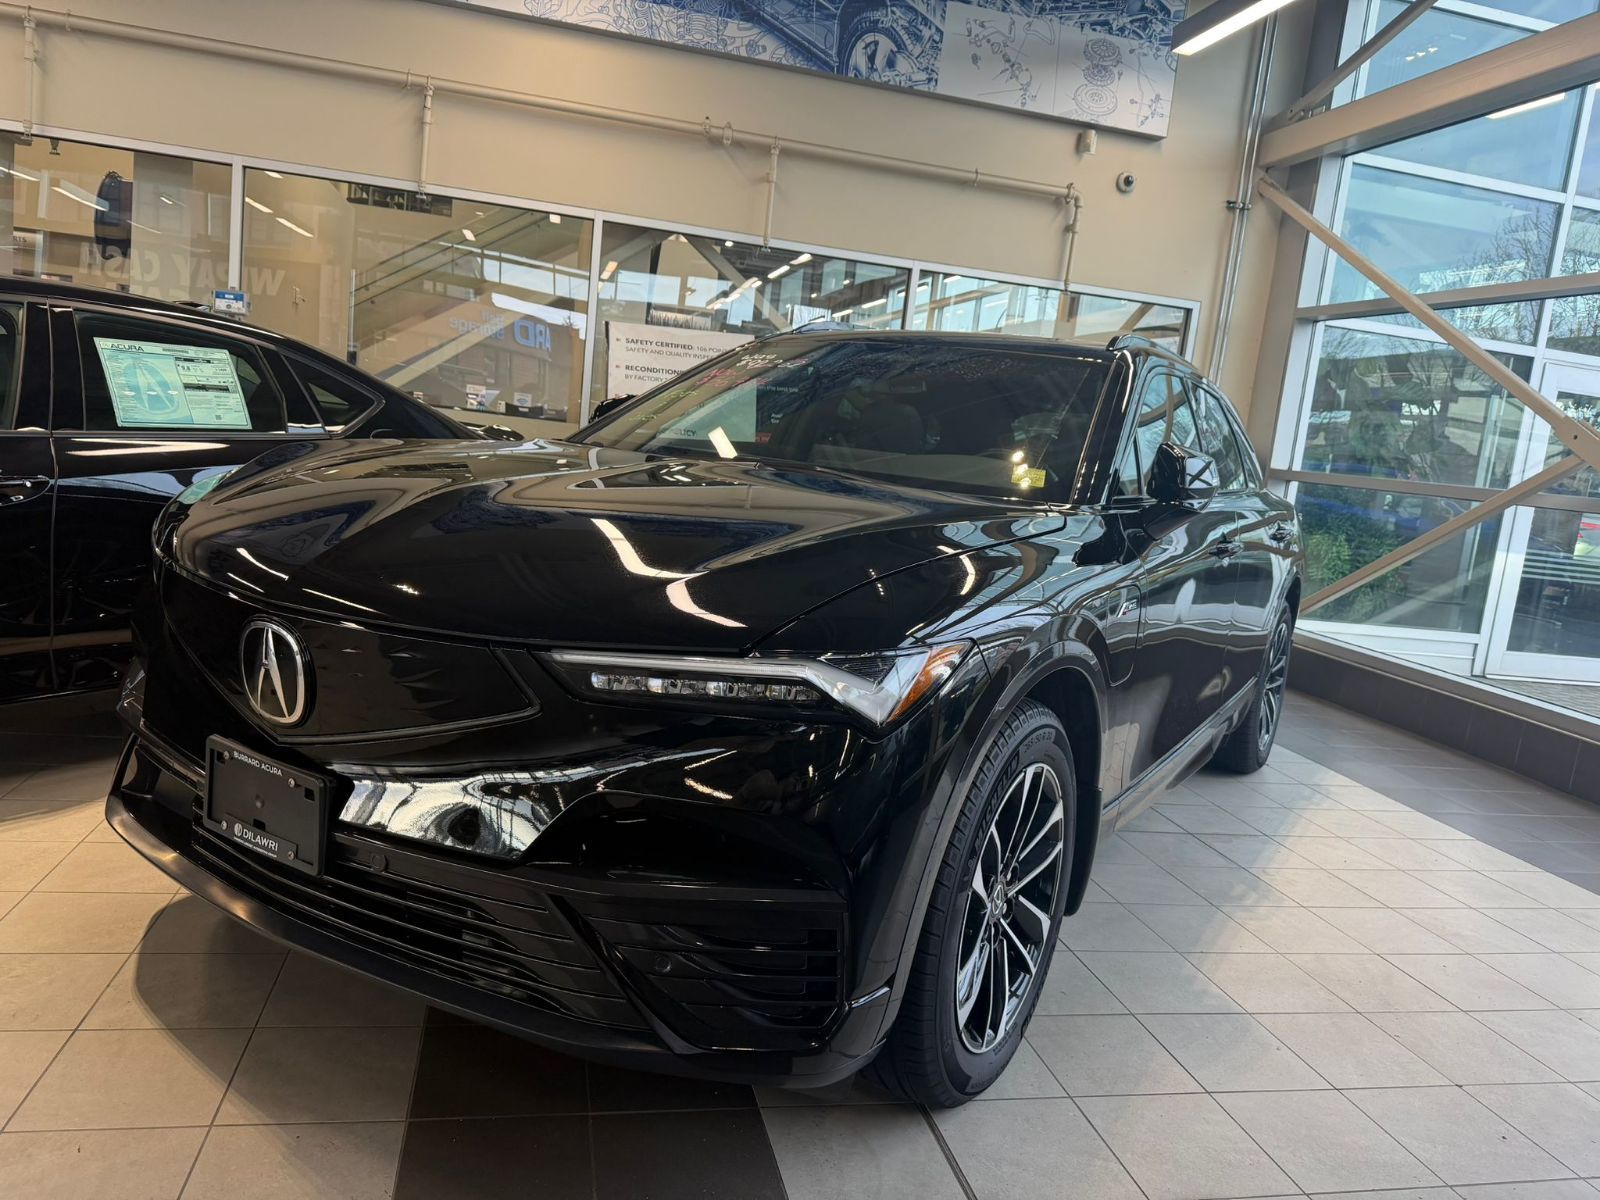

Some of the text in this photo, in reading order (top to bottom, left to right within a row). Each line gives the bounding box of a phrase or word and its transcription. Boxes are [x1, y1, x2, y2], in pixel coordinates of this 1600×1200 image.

[625, 337, 654, 346] SAFETY
[110, 343, 145, 352] ACURA
[665, 350, 692, 358] QUALITY
[625, 364, 684, 376] RECONDITION
[634, 374, 664, 383] FACTORY
[233, 750, 283, 777] BURRARD ACURA
[974, 752, 1021, 853] MICHELIN
[243, 828, 279, 852] DILAWRI
